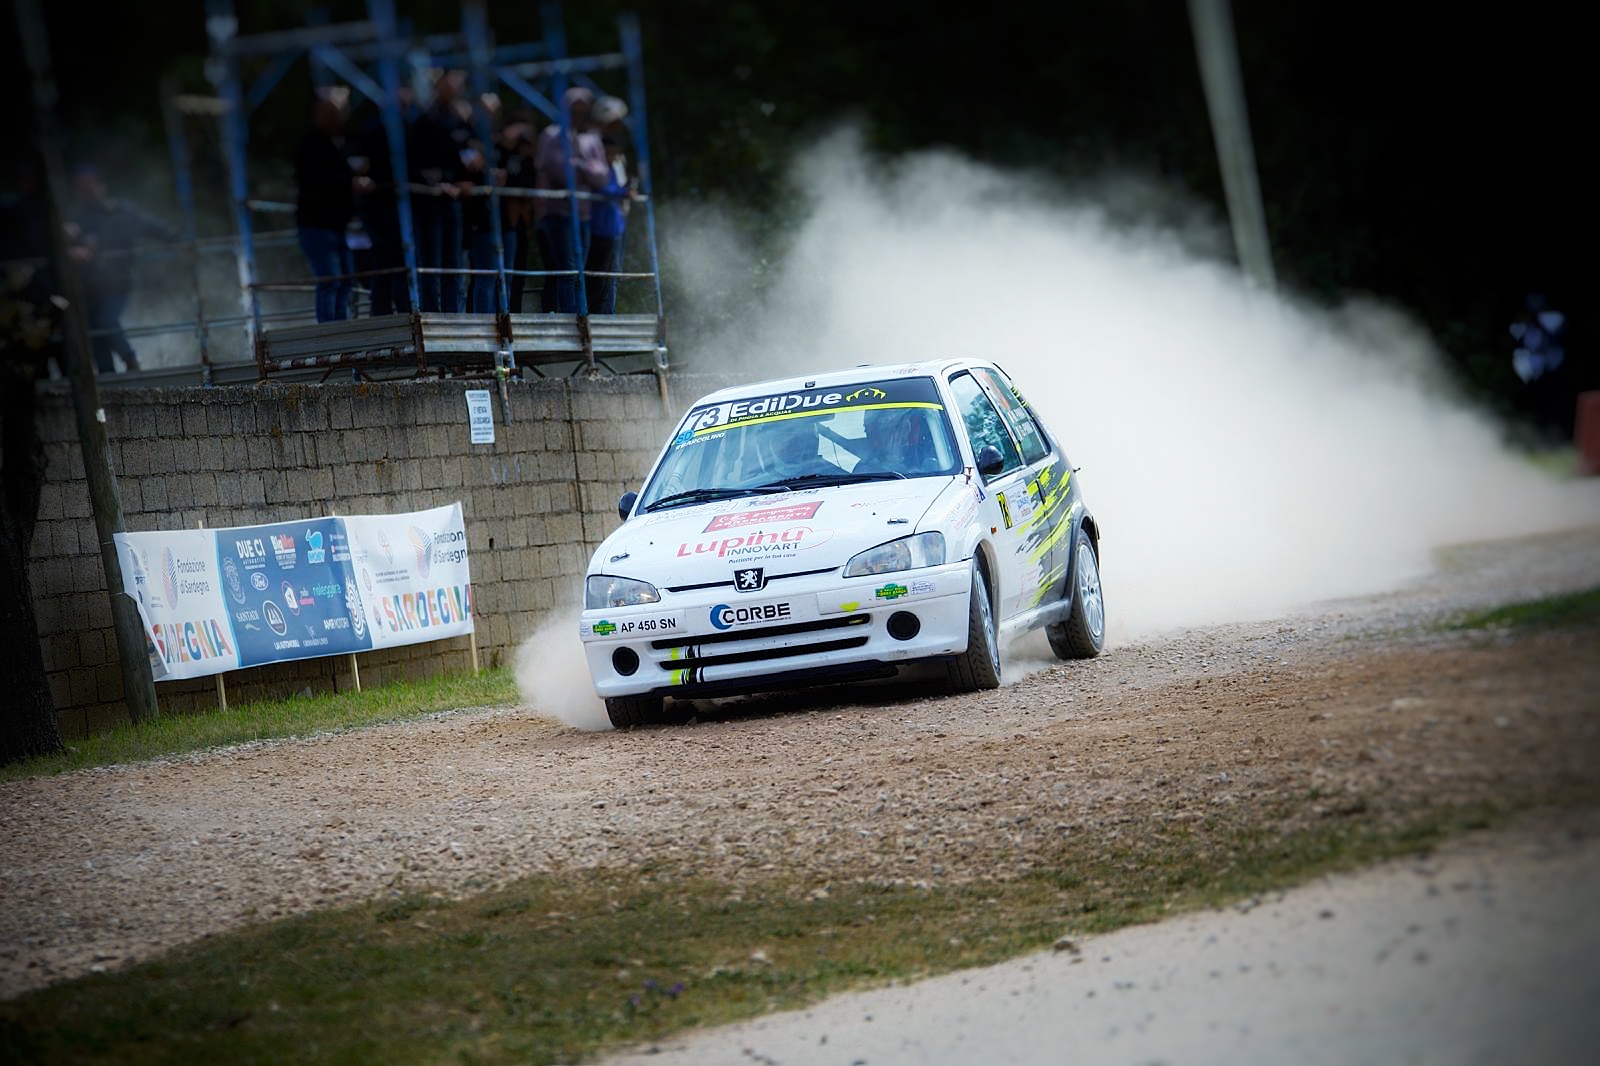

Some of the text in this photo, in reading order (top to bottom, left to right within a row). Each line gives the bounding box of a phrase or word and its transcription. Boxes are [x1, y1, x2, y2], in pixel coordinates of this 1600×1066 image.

[691, 393, 842, 430] 73 EdilDue
[236, 540, 255, 558] DUE
[727, 542, 800, 556] INNOVART
[382, 584, 474, 632] SARDEGNA
[722, 602, 791, 624] CORBE
[621, 620, 635, 633] AP
[638, 619, 657, 631] 450
[660, 617, 676, 629] SN
